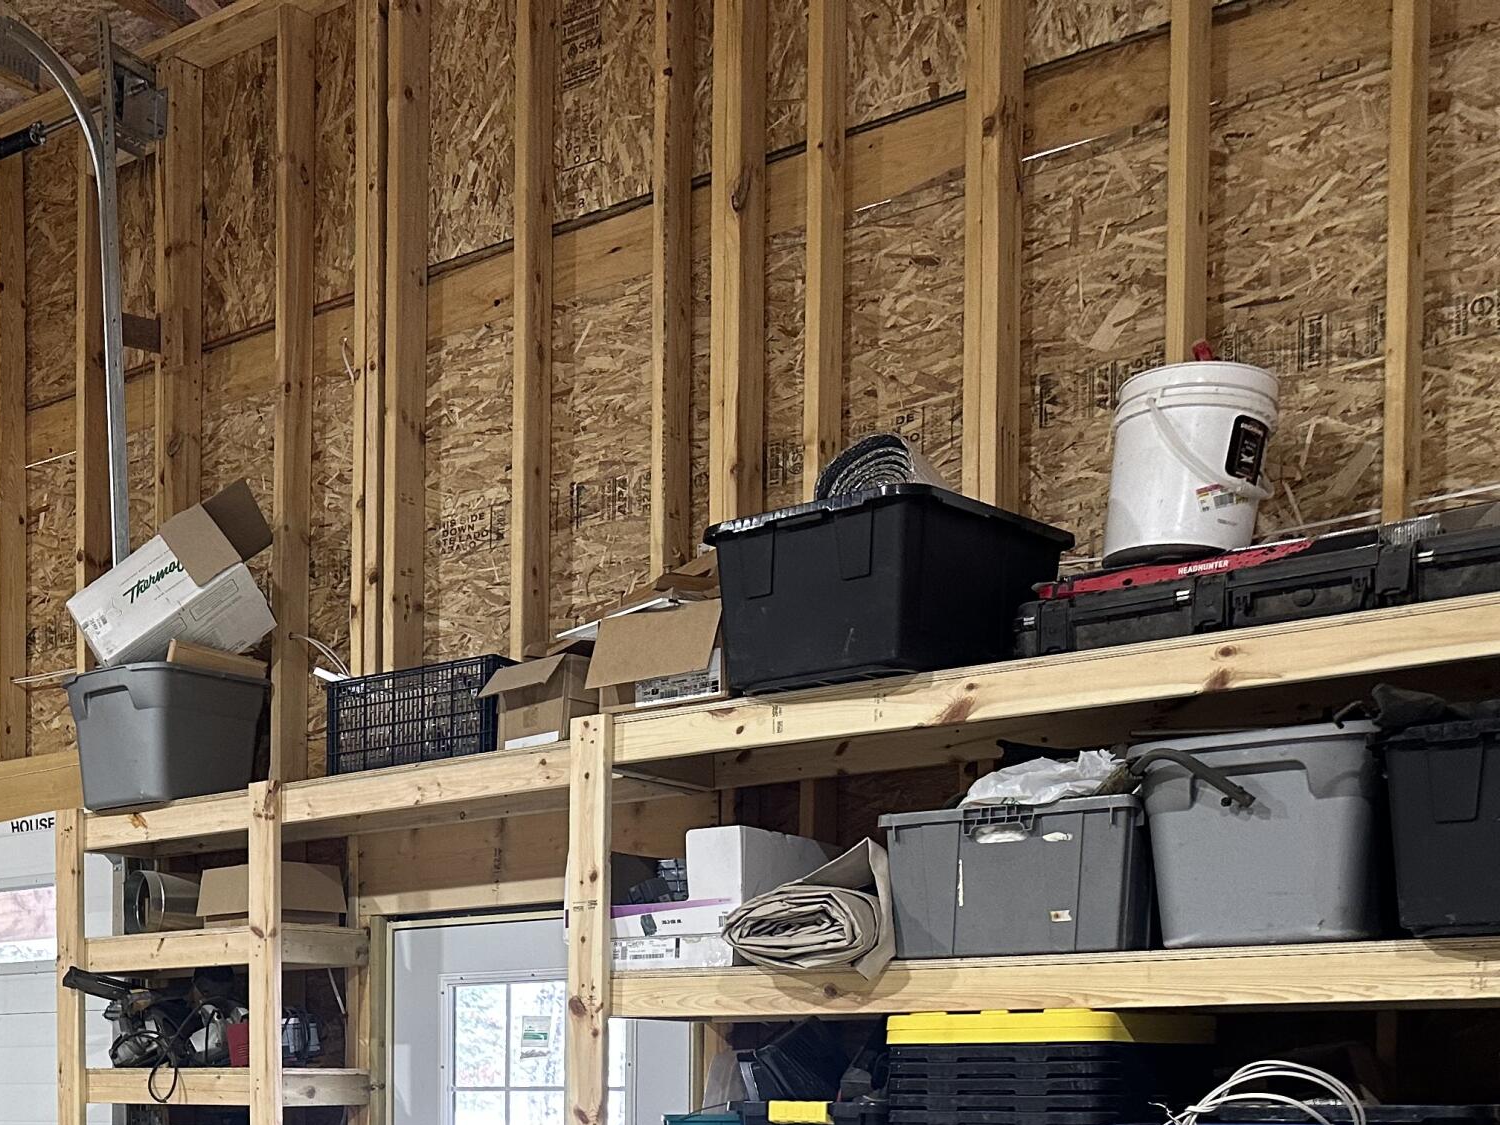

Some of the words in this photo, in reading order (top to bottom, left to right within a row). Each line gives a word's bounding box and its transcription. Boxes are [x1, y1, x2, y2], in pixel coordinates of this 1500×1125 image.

[442, 524, 475, 537] DOWN
[1177, 559, 1229, 576] HEADHUNTER
[10, 817, 55, 833] HOUSE
